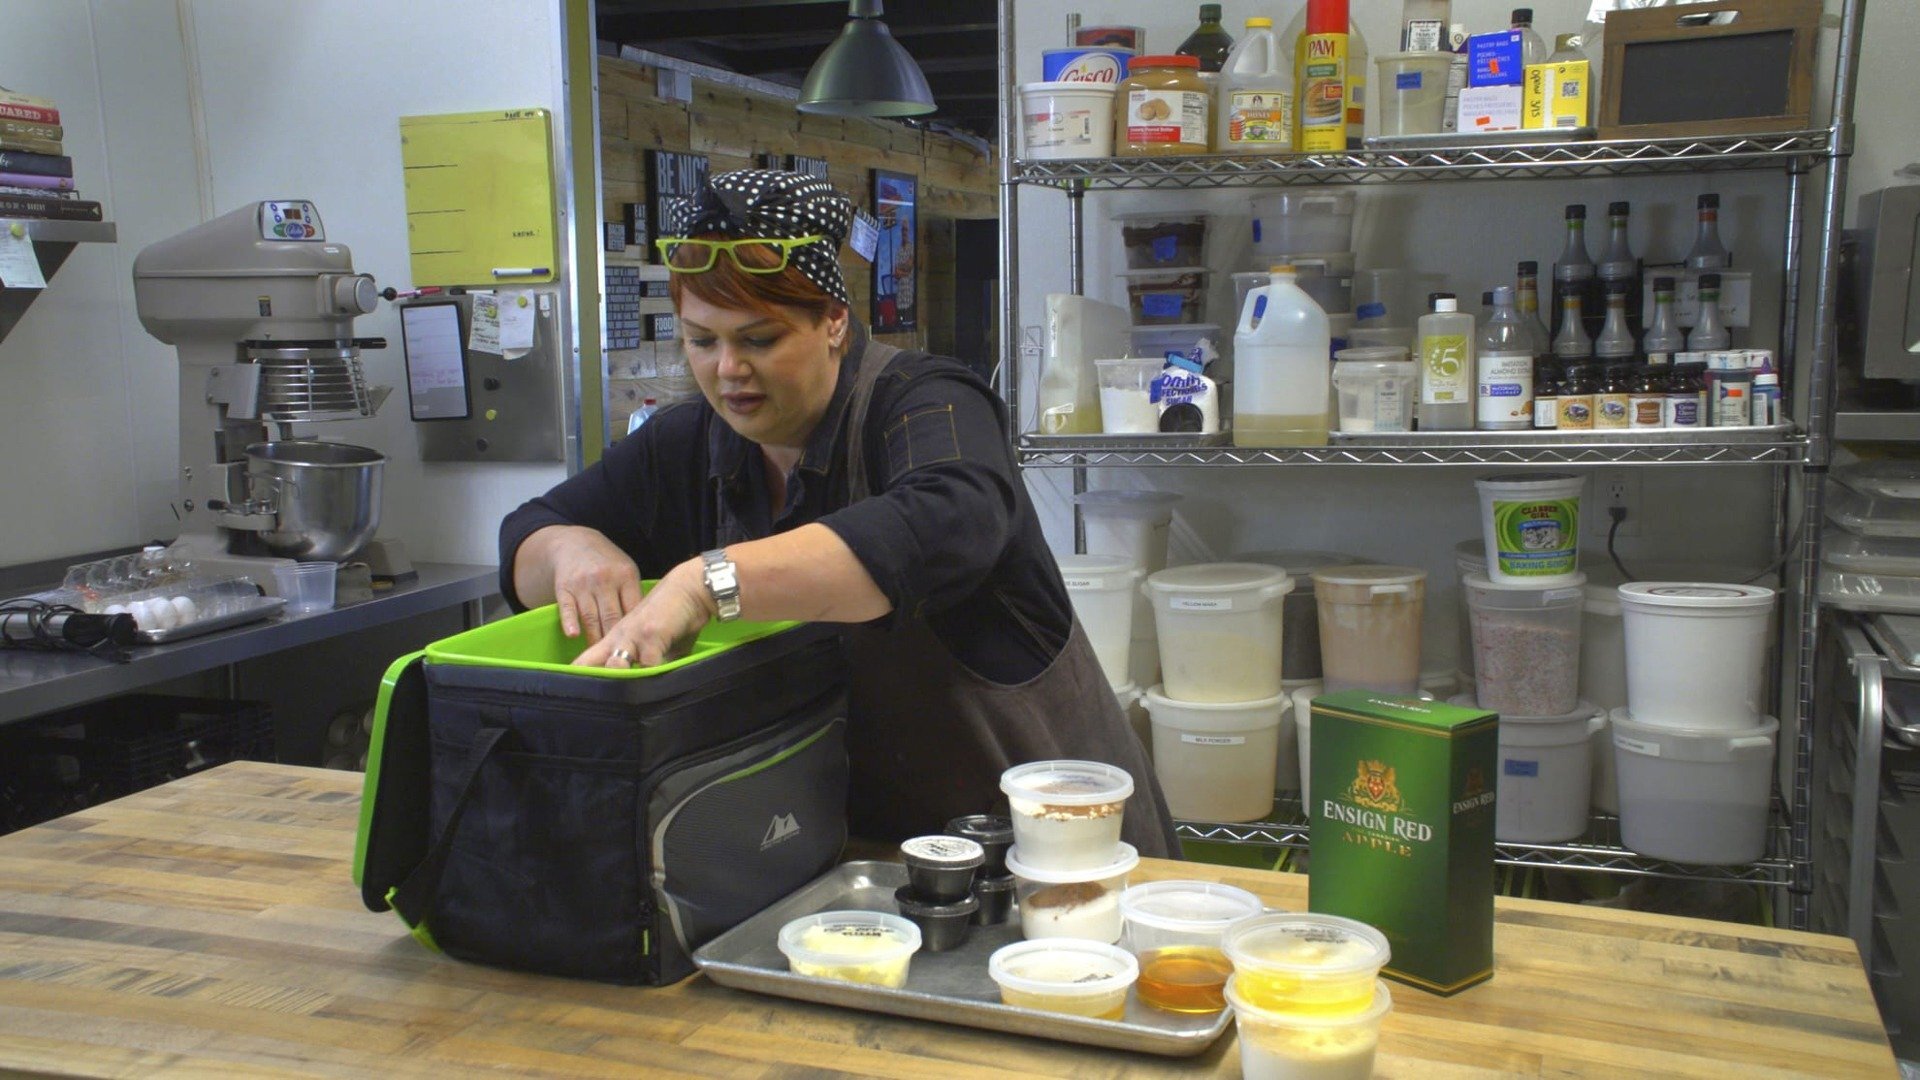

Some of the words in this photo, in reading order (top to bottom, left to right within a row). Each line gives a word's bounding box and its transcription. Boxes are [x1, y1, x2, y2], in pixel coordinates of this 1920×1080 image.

[1308, 40, 1335, 57] PAM
[657, 152, 675, 193] BE
[1509, 560, 1544, 570] BAKING
[1322, 799, 1387, 833] ENSIGN
[1393, 816, 1433, 844] RED
[1342, 832, 1412, 857] APPLE
